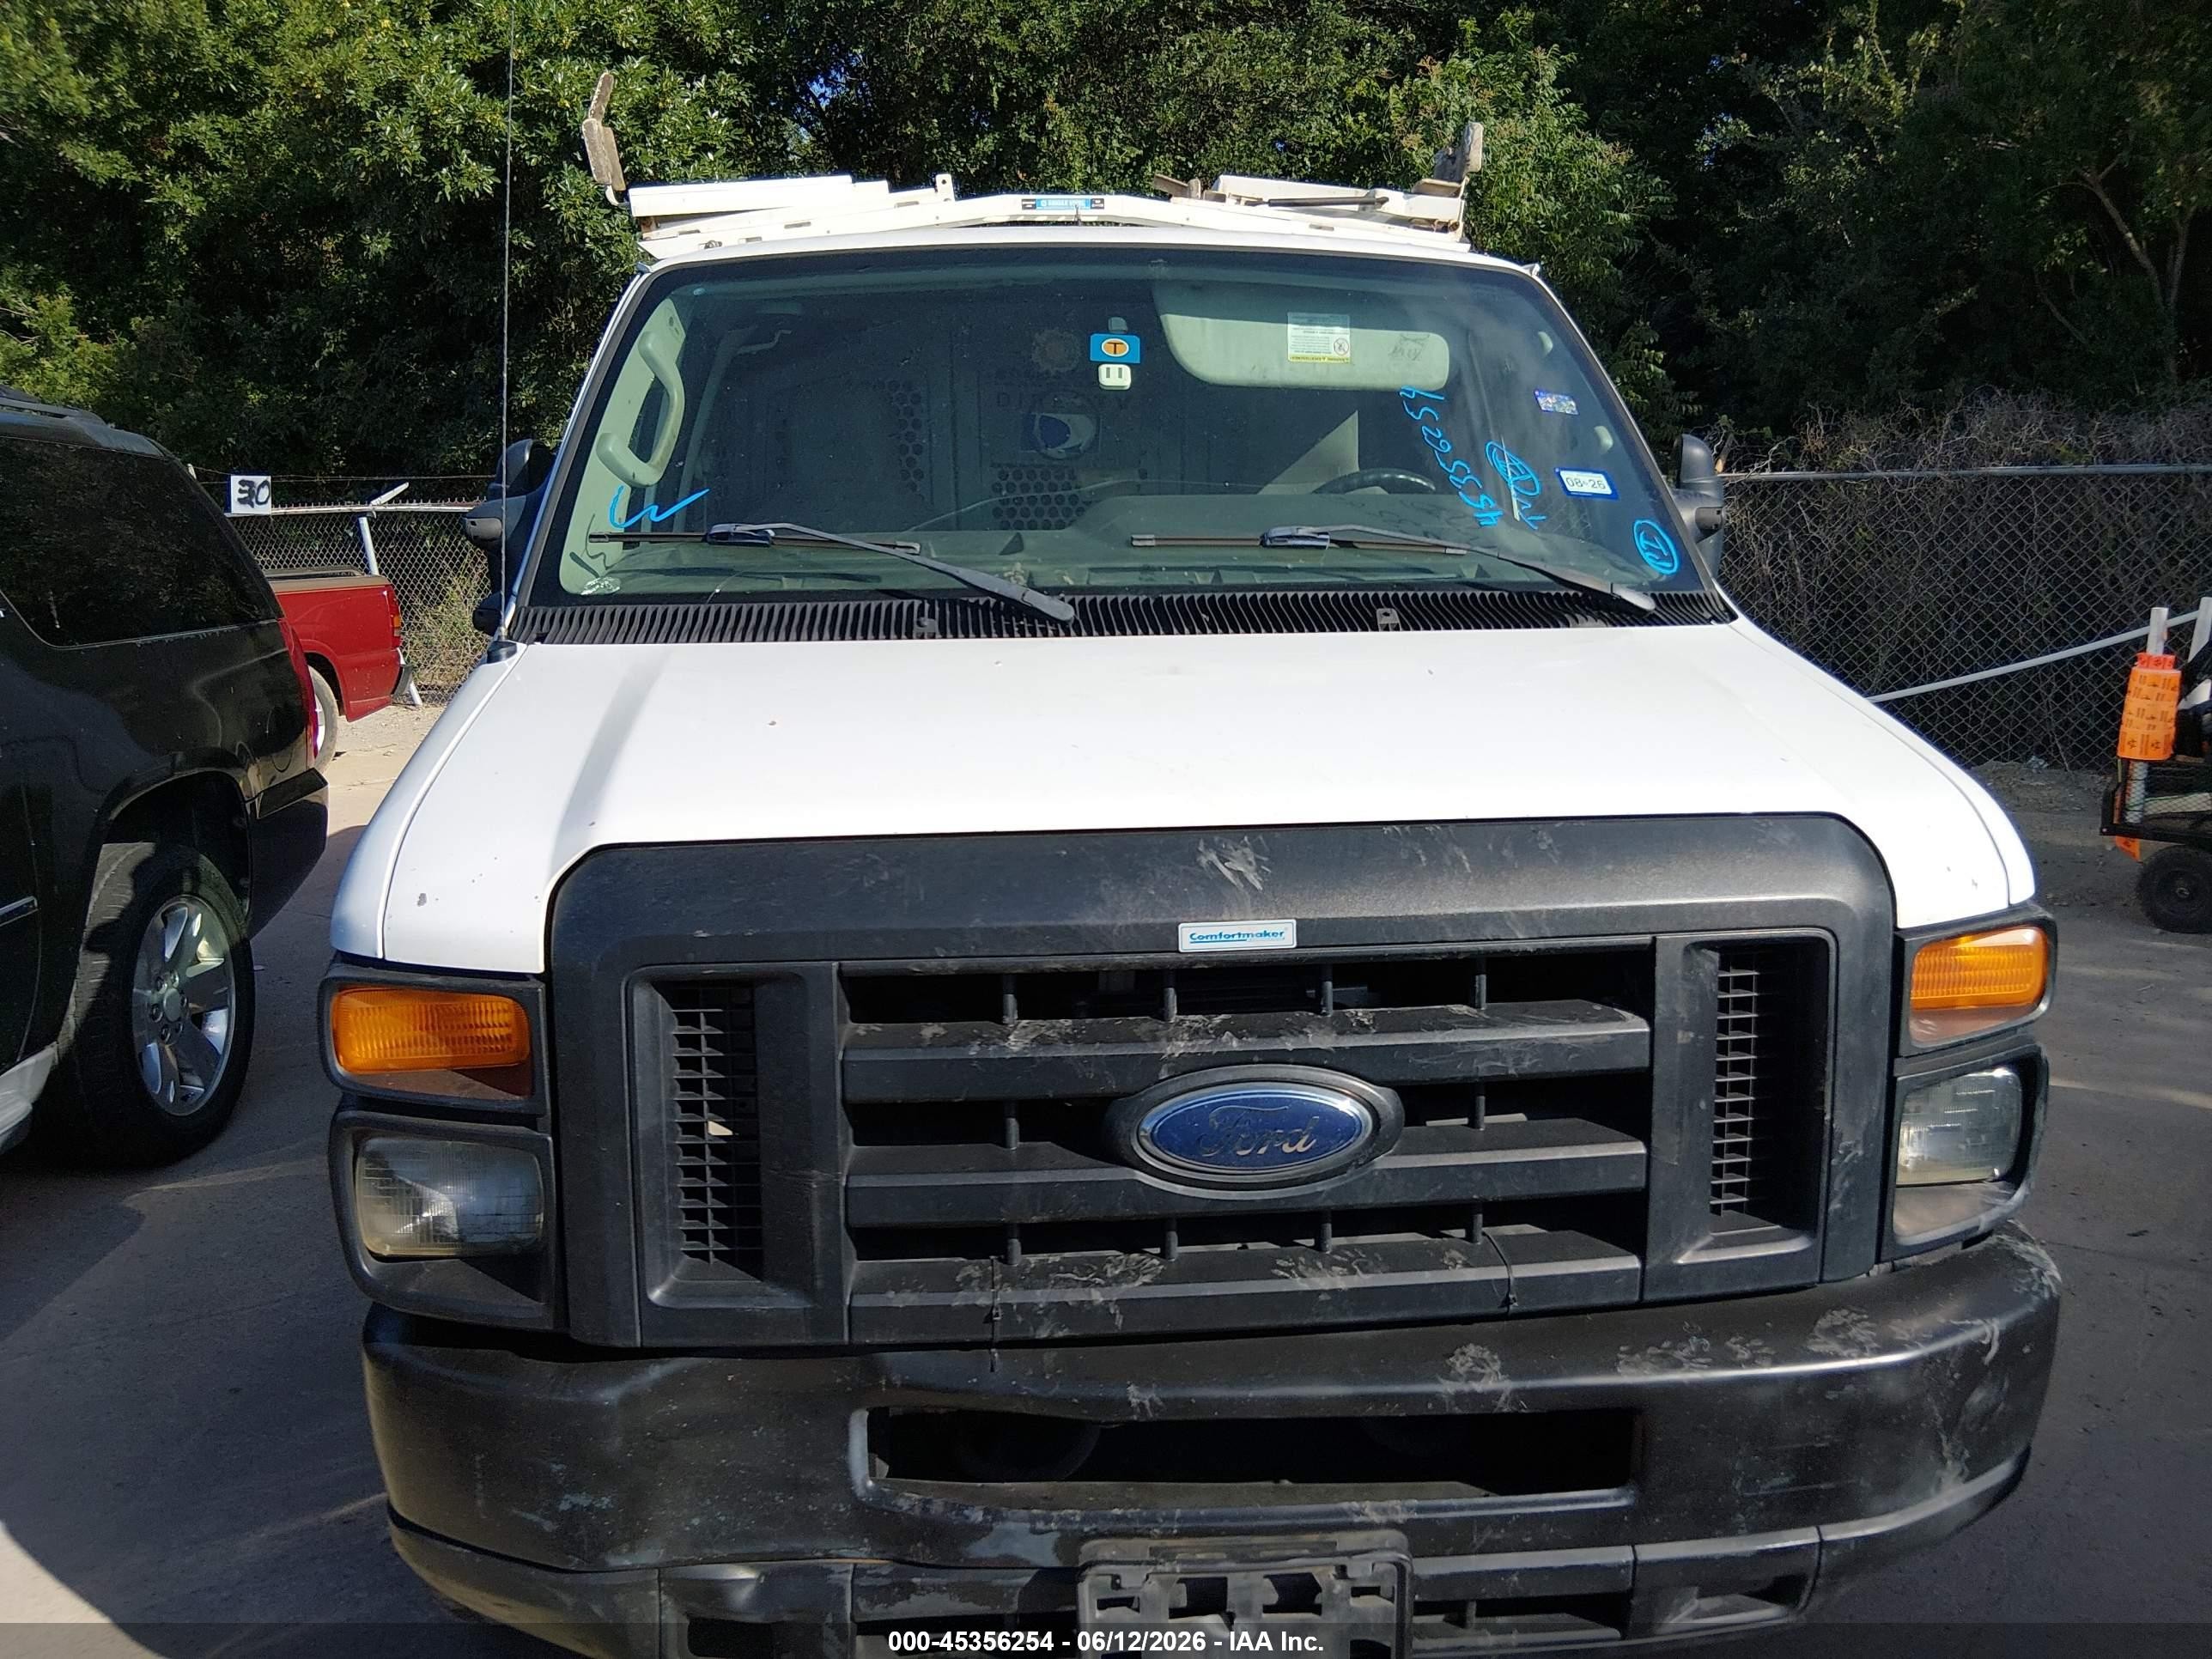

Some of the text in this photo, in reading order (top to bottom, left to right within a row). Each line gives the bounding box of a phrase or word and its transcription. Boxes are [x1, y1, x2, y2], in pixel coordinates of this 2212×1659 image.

[237, 479, 270, 508] 30
[1188, 929, 1285, 941] Comfortmaker
[1197, 1105, 1320, 1158] Ford
